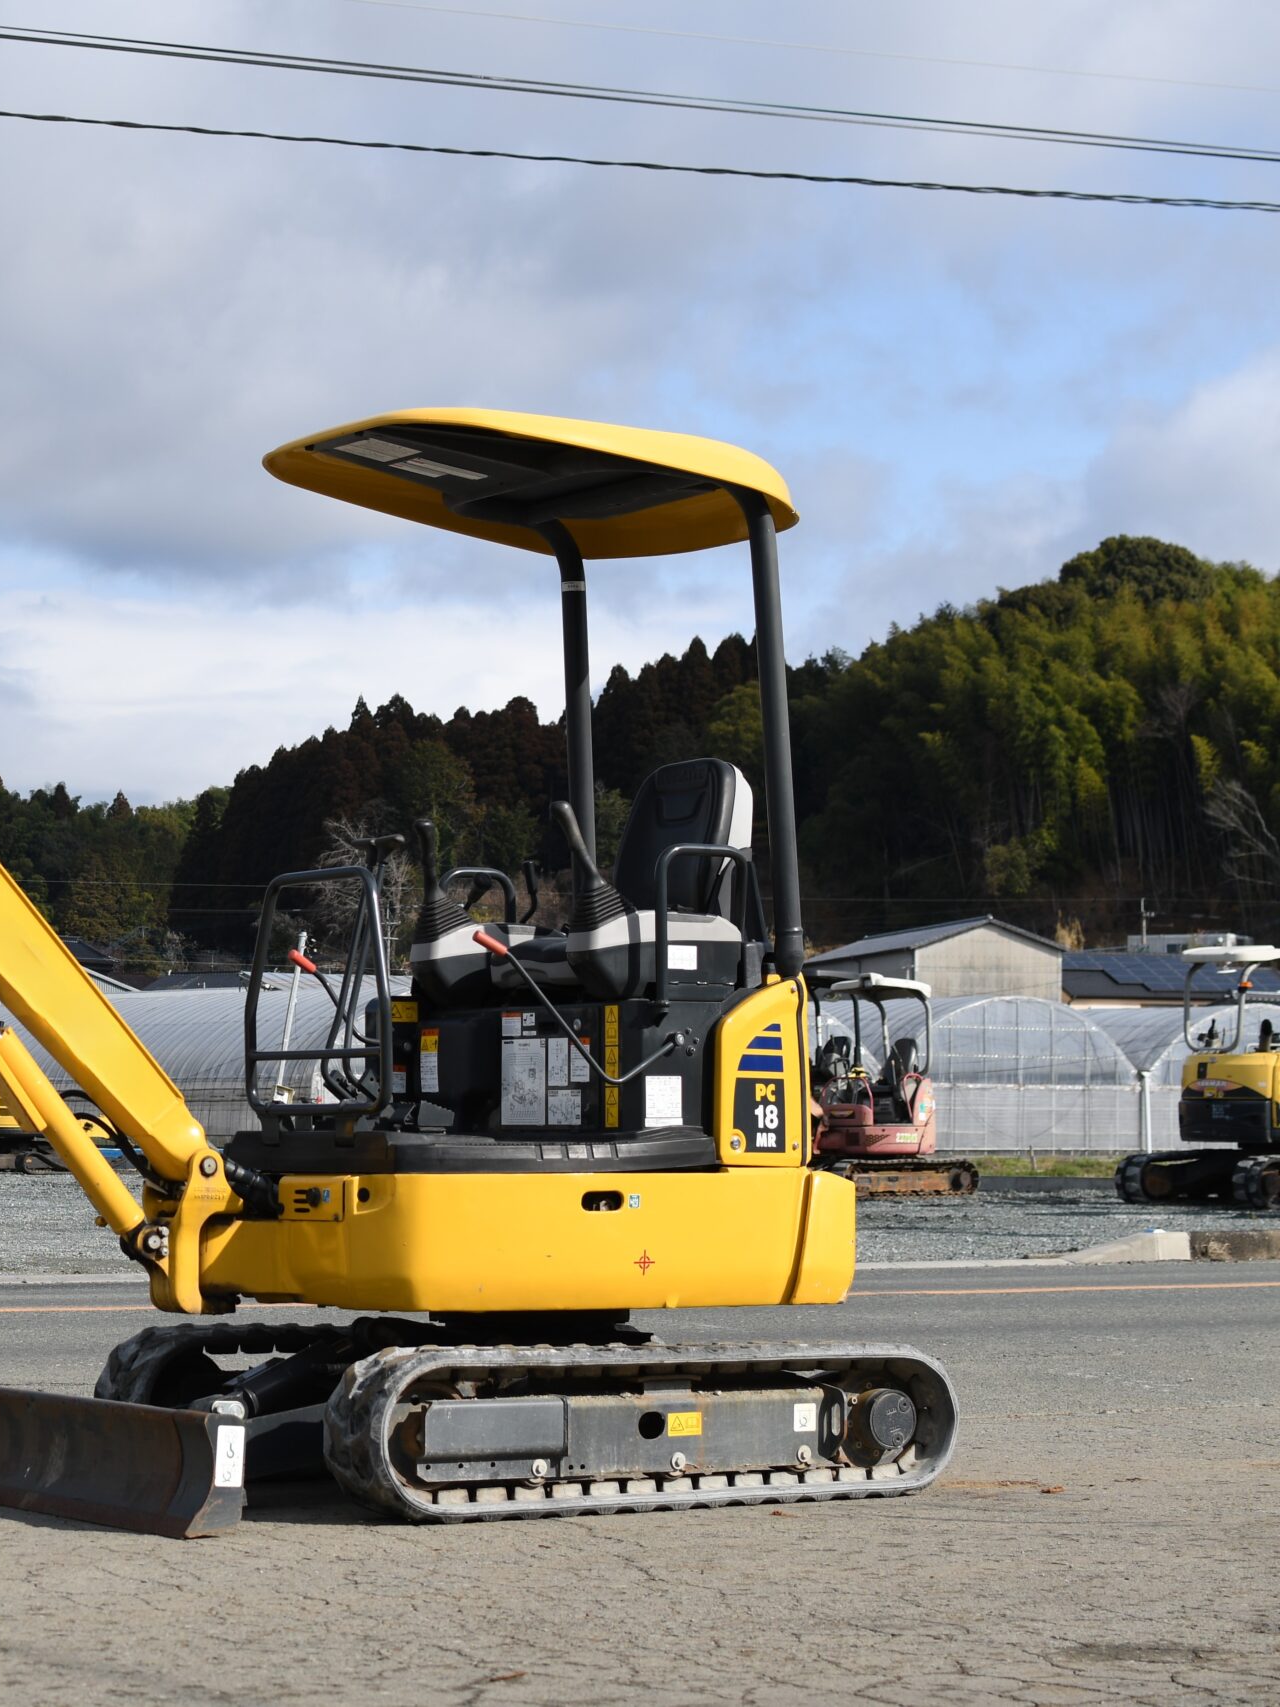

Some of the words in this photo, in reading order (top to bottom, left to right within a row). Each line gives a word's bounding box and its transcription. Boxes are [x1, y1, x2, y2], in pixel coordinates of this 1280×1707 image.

[755, 1083, 776, 1102] PC
[754, 1104, 779, 1129] 18
[756, 1132, 777, 1148] MR
